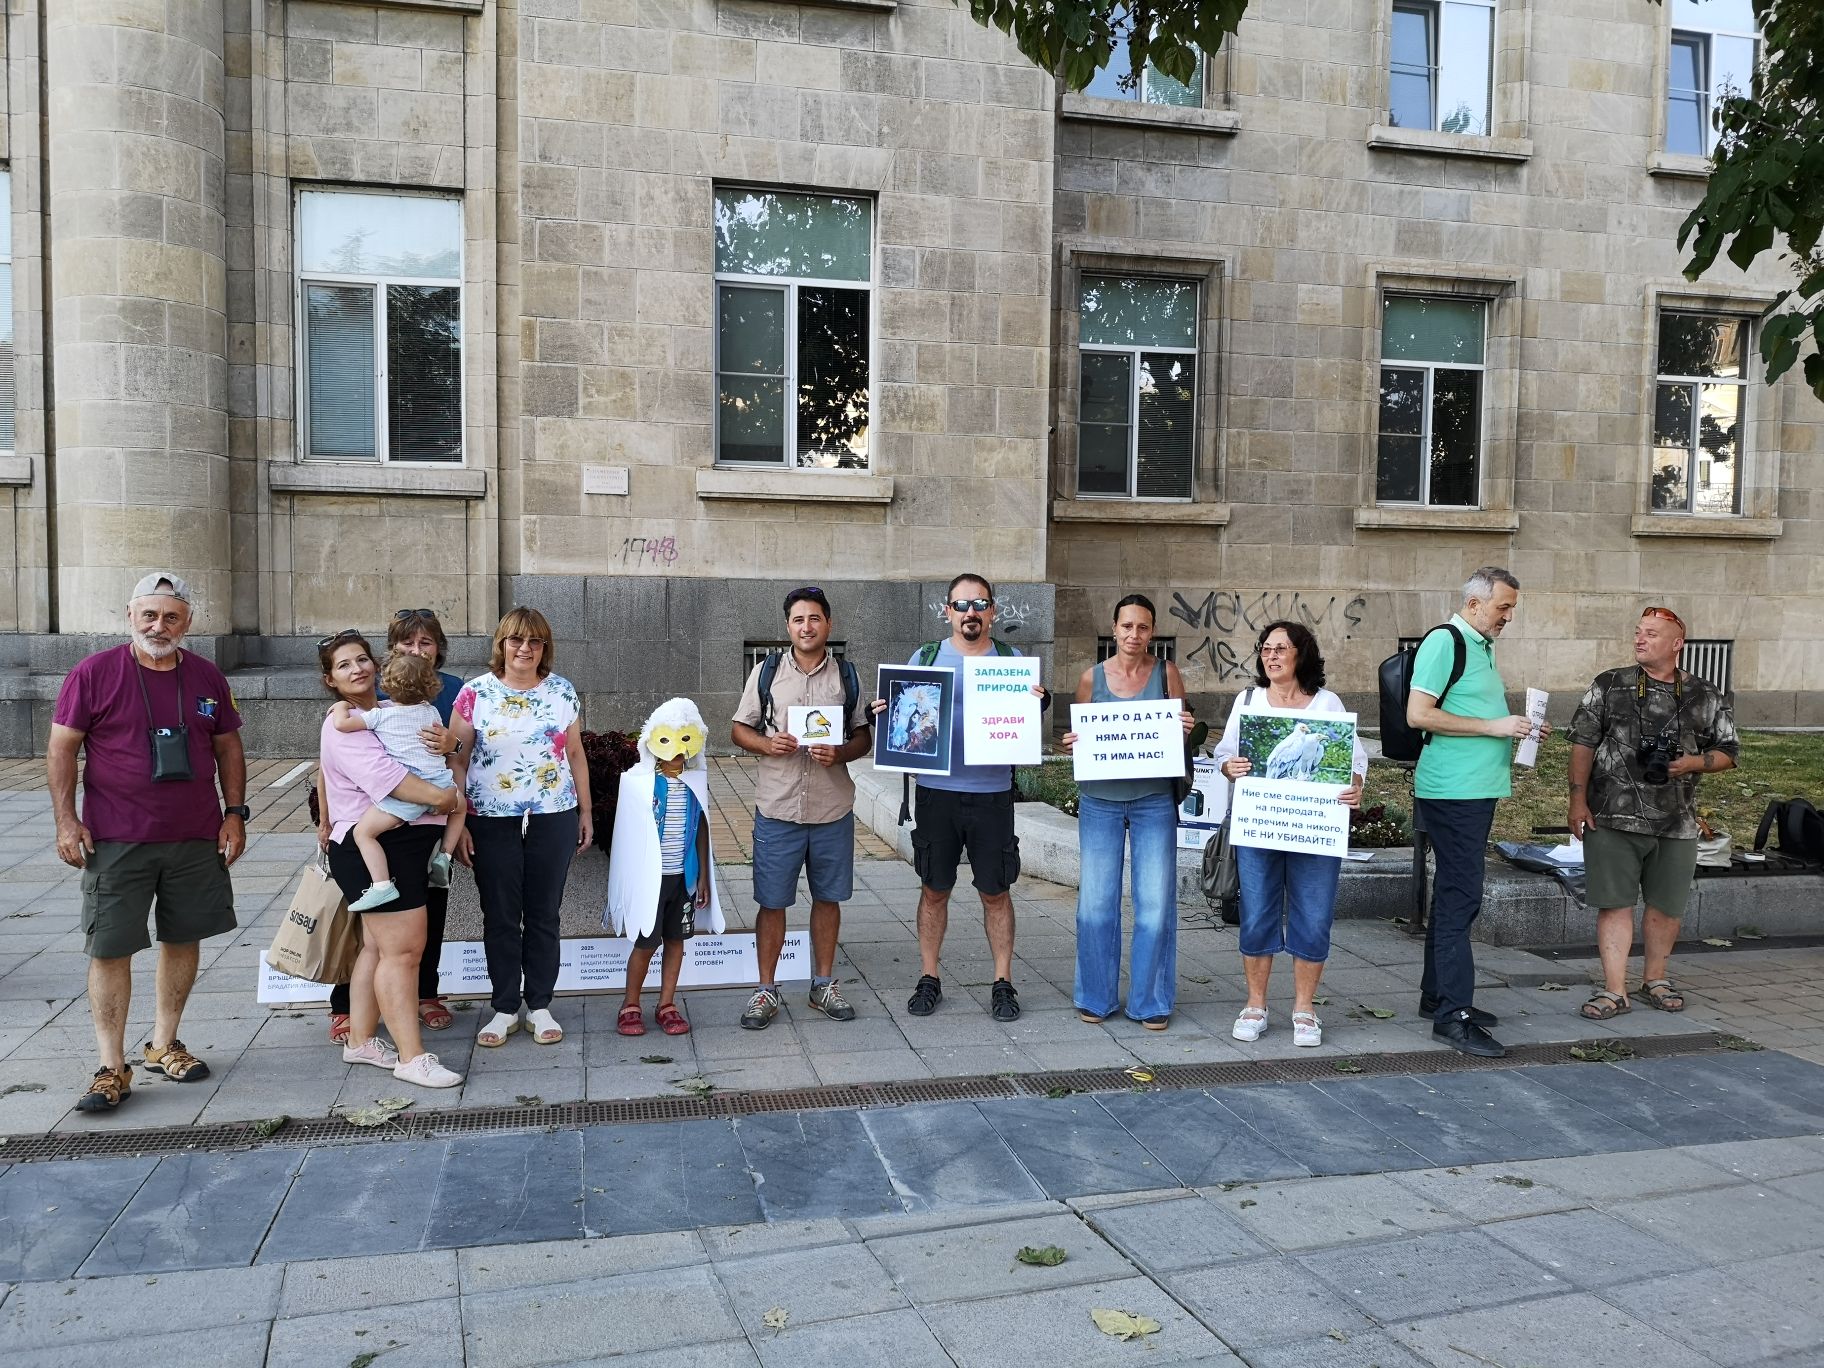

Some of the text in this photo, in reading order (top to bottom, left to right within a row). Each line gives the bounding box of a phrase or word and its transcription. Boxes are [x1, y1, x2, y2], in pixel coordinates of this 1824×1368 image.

[974, 668, 1031, 677] ЗАПАЗЕНА
[977, 684, 1028, 692] ПРИРОДА
[981, 716, 1025, 725] ЗДРАВИ
[1080, 712, 1173, 723] ПРИРОДАТА
[989, 732, 1019, 740] ХОРА
[1095, 732, 1159, 741] НЯМА ГЛАС
[1093, 751, 1164, 761] ТЯ ИМА НАС!
[1241, 788, 1342, 808] Ние сме санитарите
[1270, 806, 1327, 819] природата,
[1252, 817, 1289, 827] пречим
[1306, 823, 1344, 834] никого,
[1243, 829, 1336, 846] НЕ НИ УБИВАЙТЕ!
